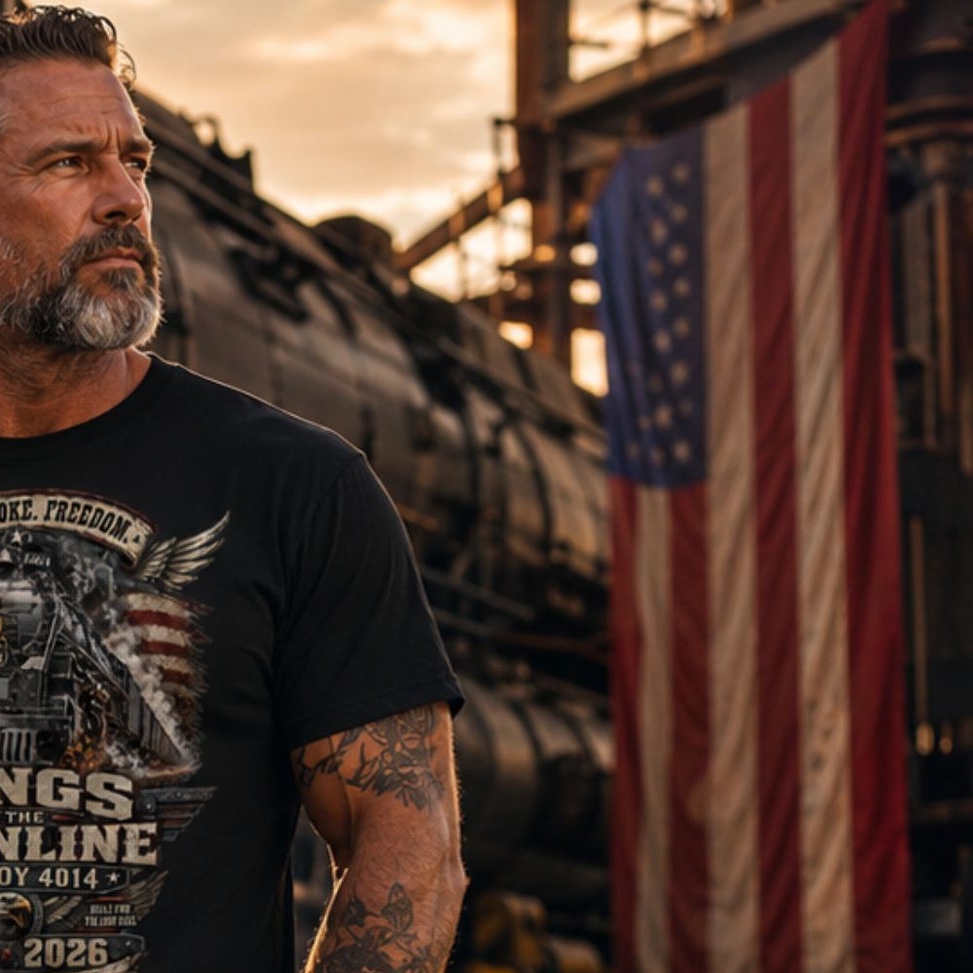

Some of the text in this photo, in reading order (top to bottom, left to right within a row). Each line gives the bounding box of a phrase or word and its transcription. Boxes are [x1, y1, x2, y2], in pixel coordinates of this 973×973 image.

[44, 499, 135, 543] FREEDOM.
[5, 811, 45, 824] THE
[38, 867, 99, 889] 4014
[23, 937, 108, 968] 2026
